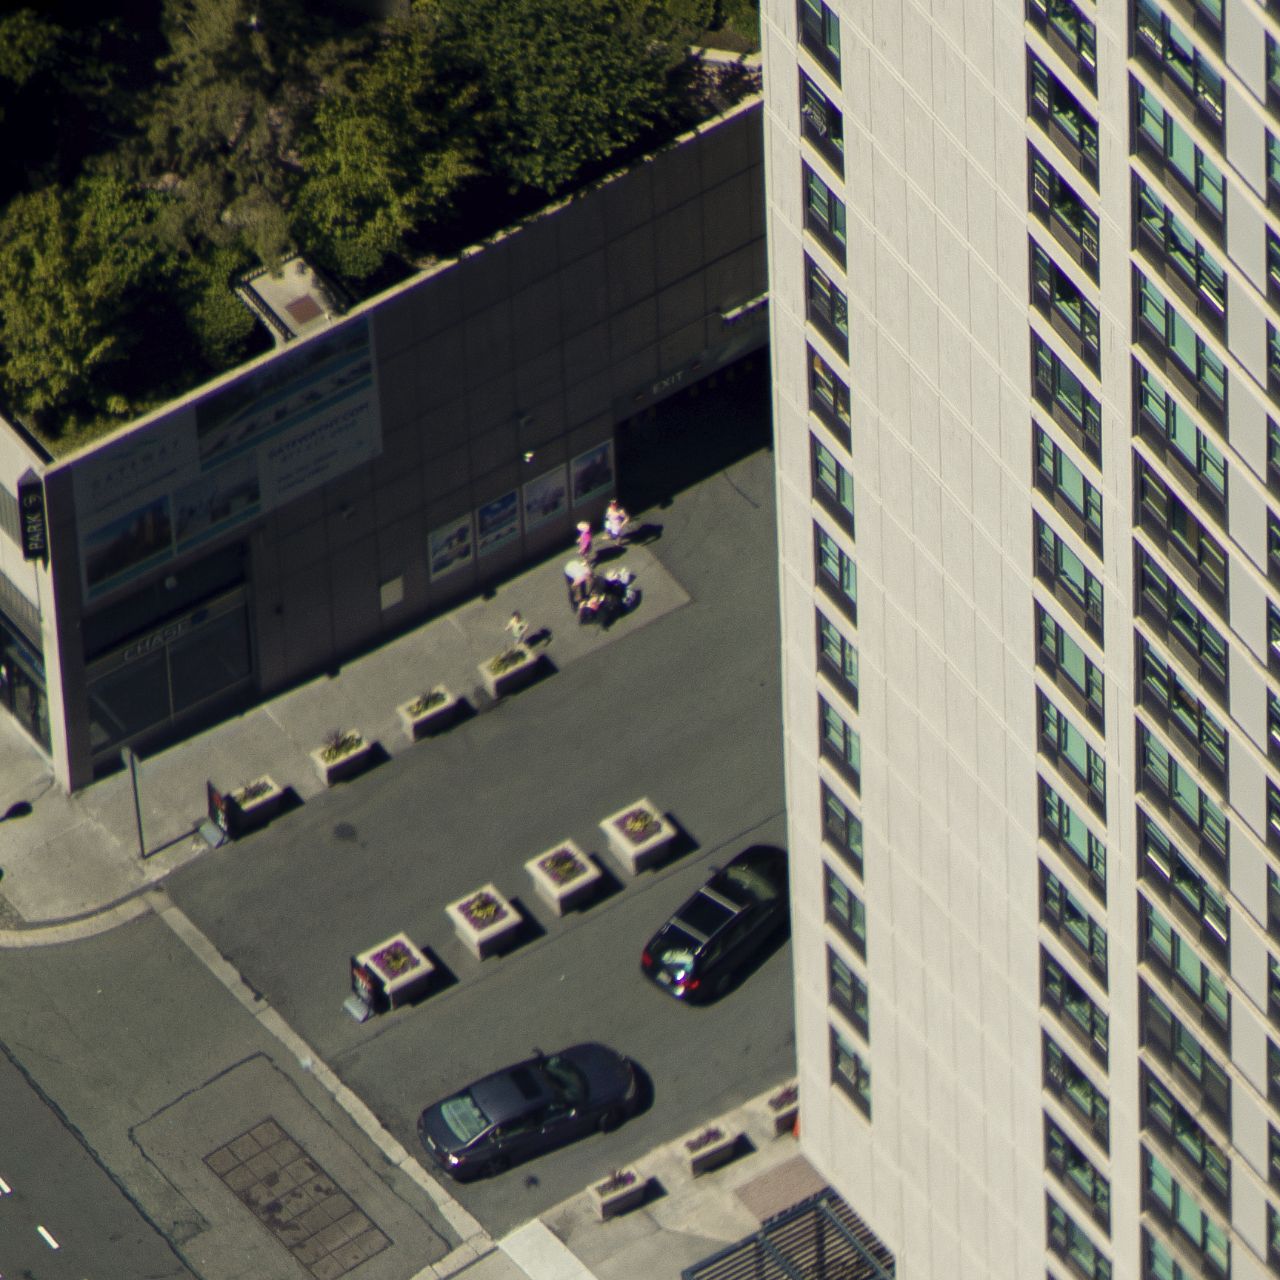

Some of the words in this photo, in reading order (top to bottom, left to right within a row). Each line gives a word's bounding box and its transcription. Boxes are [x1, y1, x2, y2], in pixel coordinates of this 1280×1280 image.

[652, 370, 685, 395] EXIT
[25, 512, 45, 552] PARK
[123, 623, 189, 662] CHASE
